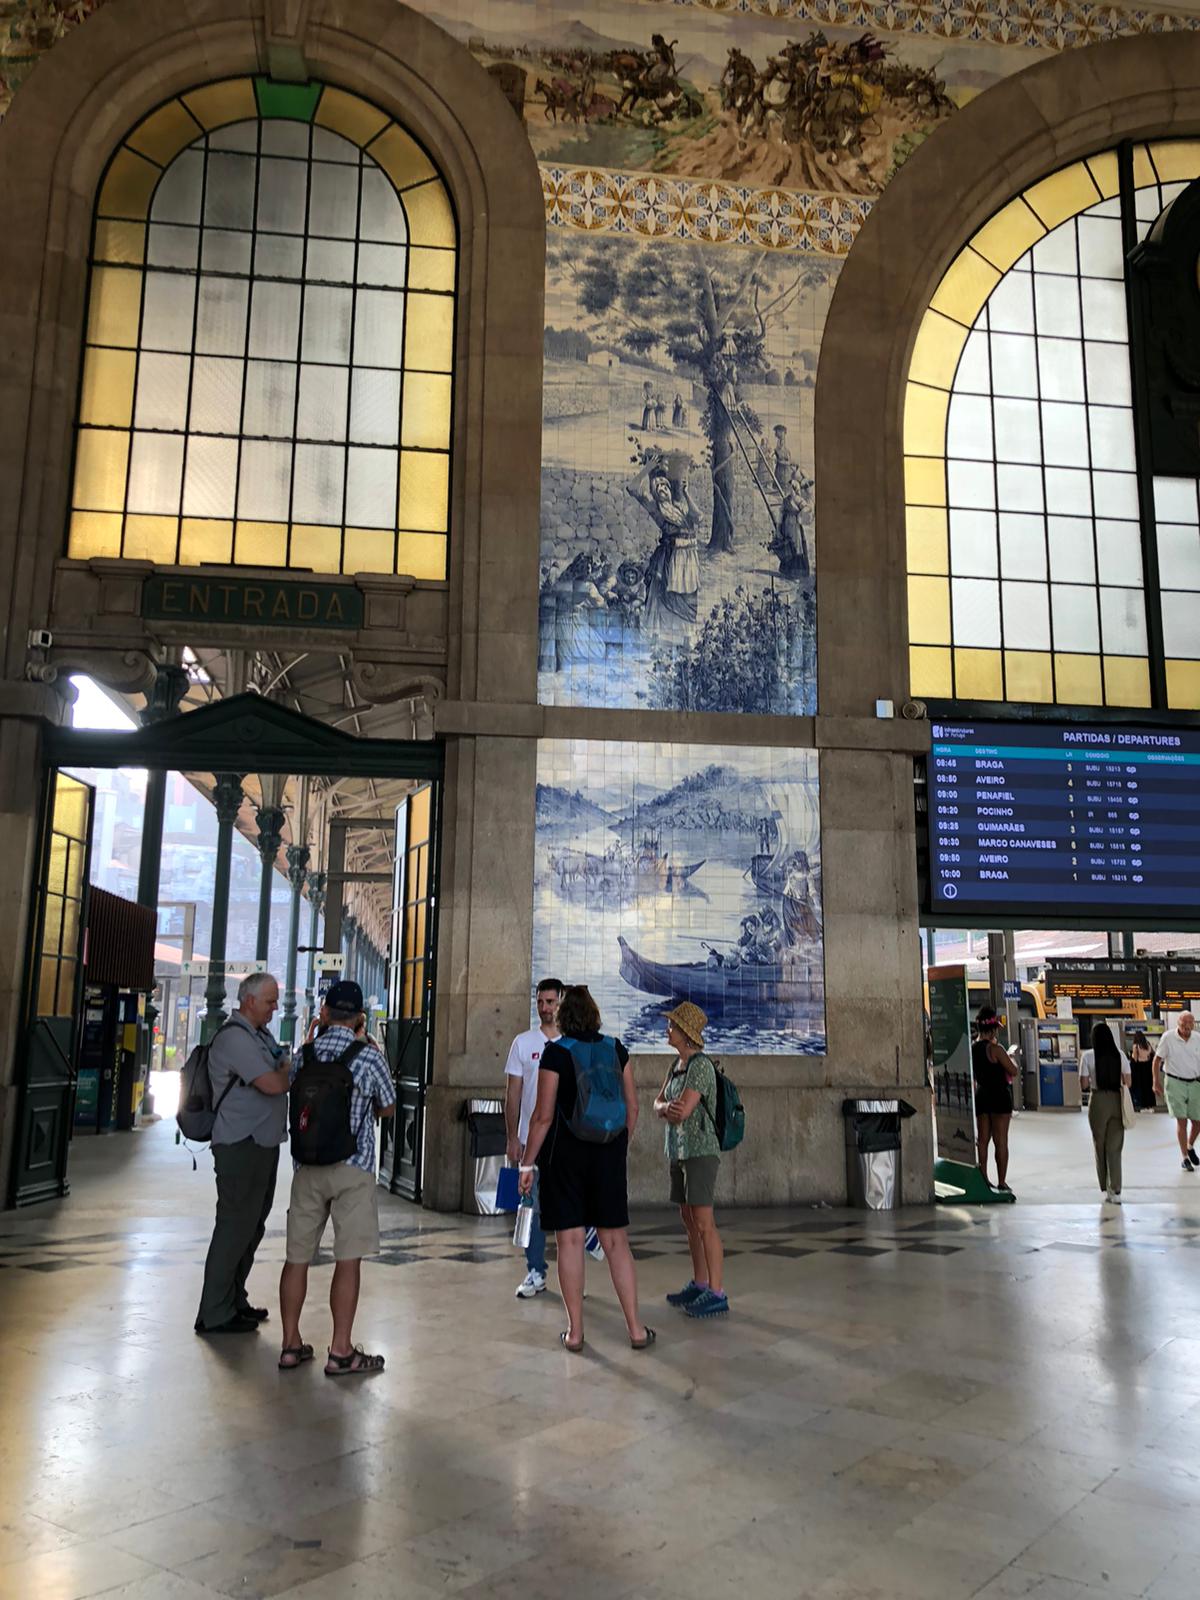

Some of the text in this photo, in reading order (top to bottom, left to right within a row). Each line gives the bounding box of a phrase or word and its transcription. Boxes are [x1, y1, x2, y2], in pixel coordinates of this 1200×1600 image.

[162, 582, 344, 620] ENTRADA
[1063, 732, 1111, 744] PARTIDAS
[1118, 735, 1181, 746] DEPARTURES
[975, 760, 1004, 769] BRAGA
[976, 776, 1005, 785] AVEIRO
[1067, 779, 1073, 787] 4
[977, 791, 1015, 801] PENAFIEL
[977, 807, 1013, 816] POCINHO
[1070, 810, 1074, 819] 1
[978, 823, 1025, 832] GUIMARÃES
[979, 838, 1007, 847] MARCO
[1010, 839, 1056, 849] CANAVESES
[979, 854, 1008, 863] AVEIRO
[940, 870, 960, 878] 10:00
[980, 870, 1008, 879] BRAGA
